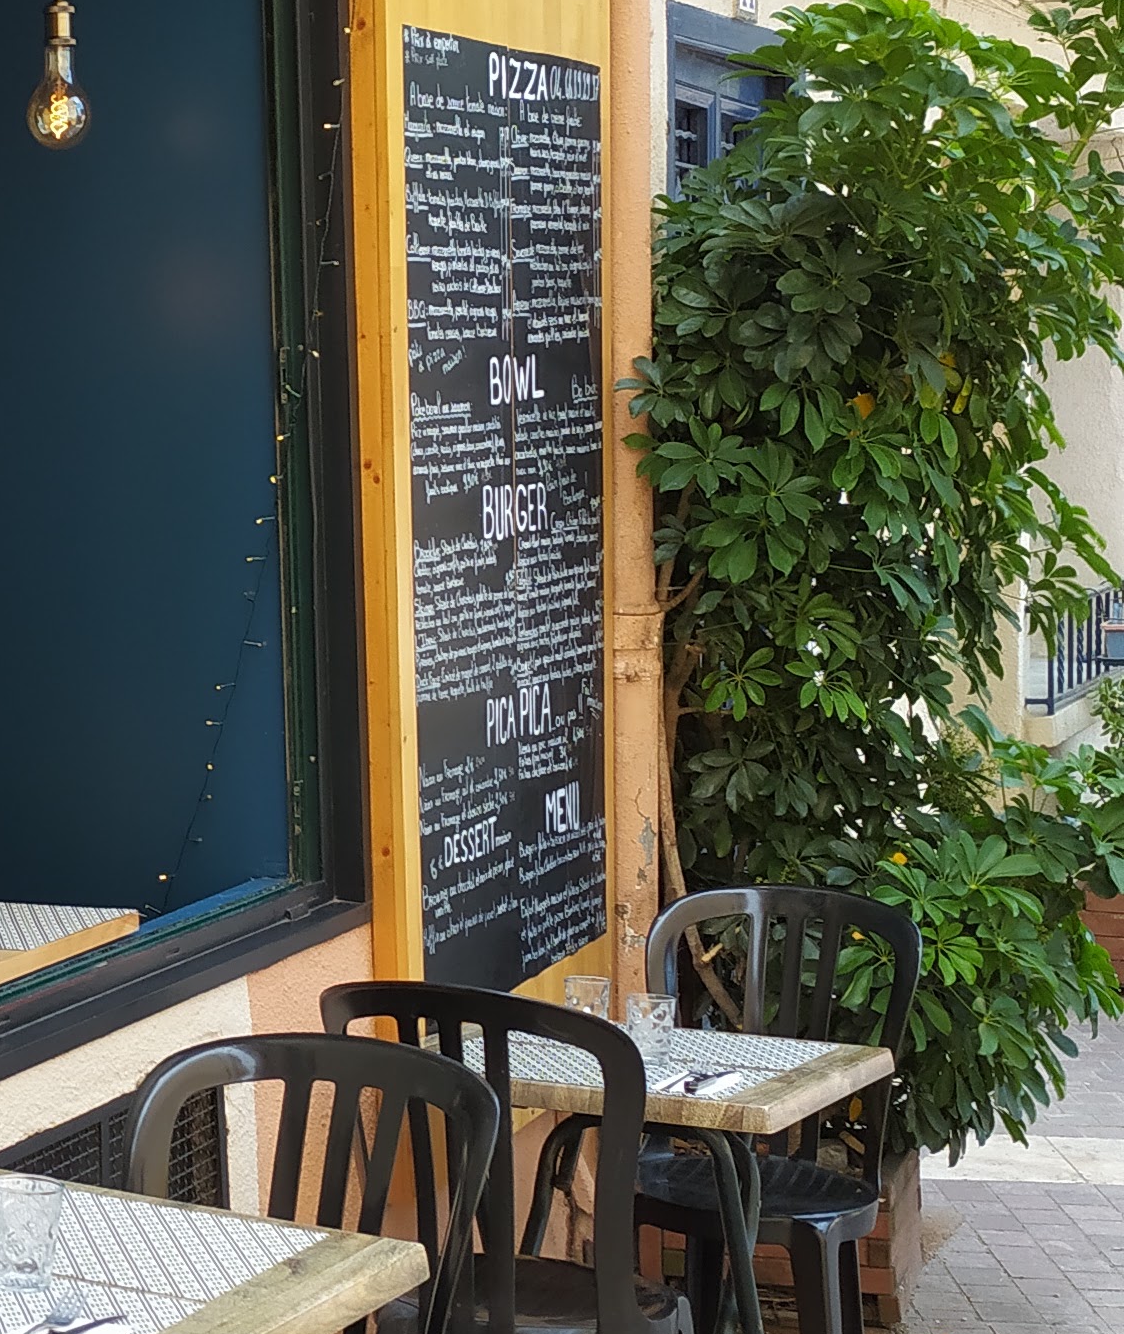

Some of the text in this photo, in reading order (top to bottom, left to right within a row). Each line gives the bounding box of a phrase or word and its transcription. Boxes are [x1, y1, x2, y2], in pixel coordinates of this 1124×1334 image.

[488, 51, 549, 102] PIZZA
[488, 353, 546, 406] BOWL
[482, 482, 549, 542] BURGER
[485, 694, 517, 748] PICA
[518, 682, 553, 738] PICA
[545, 780, 581, 834] MENU
[443, 814, 499, 869] DESSERT
